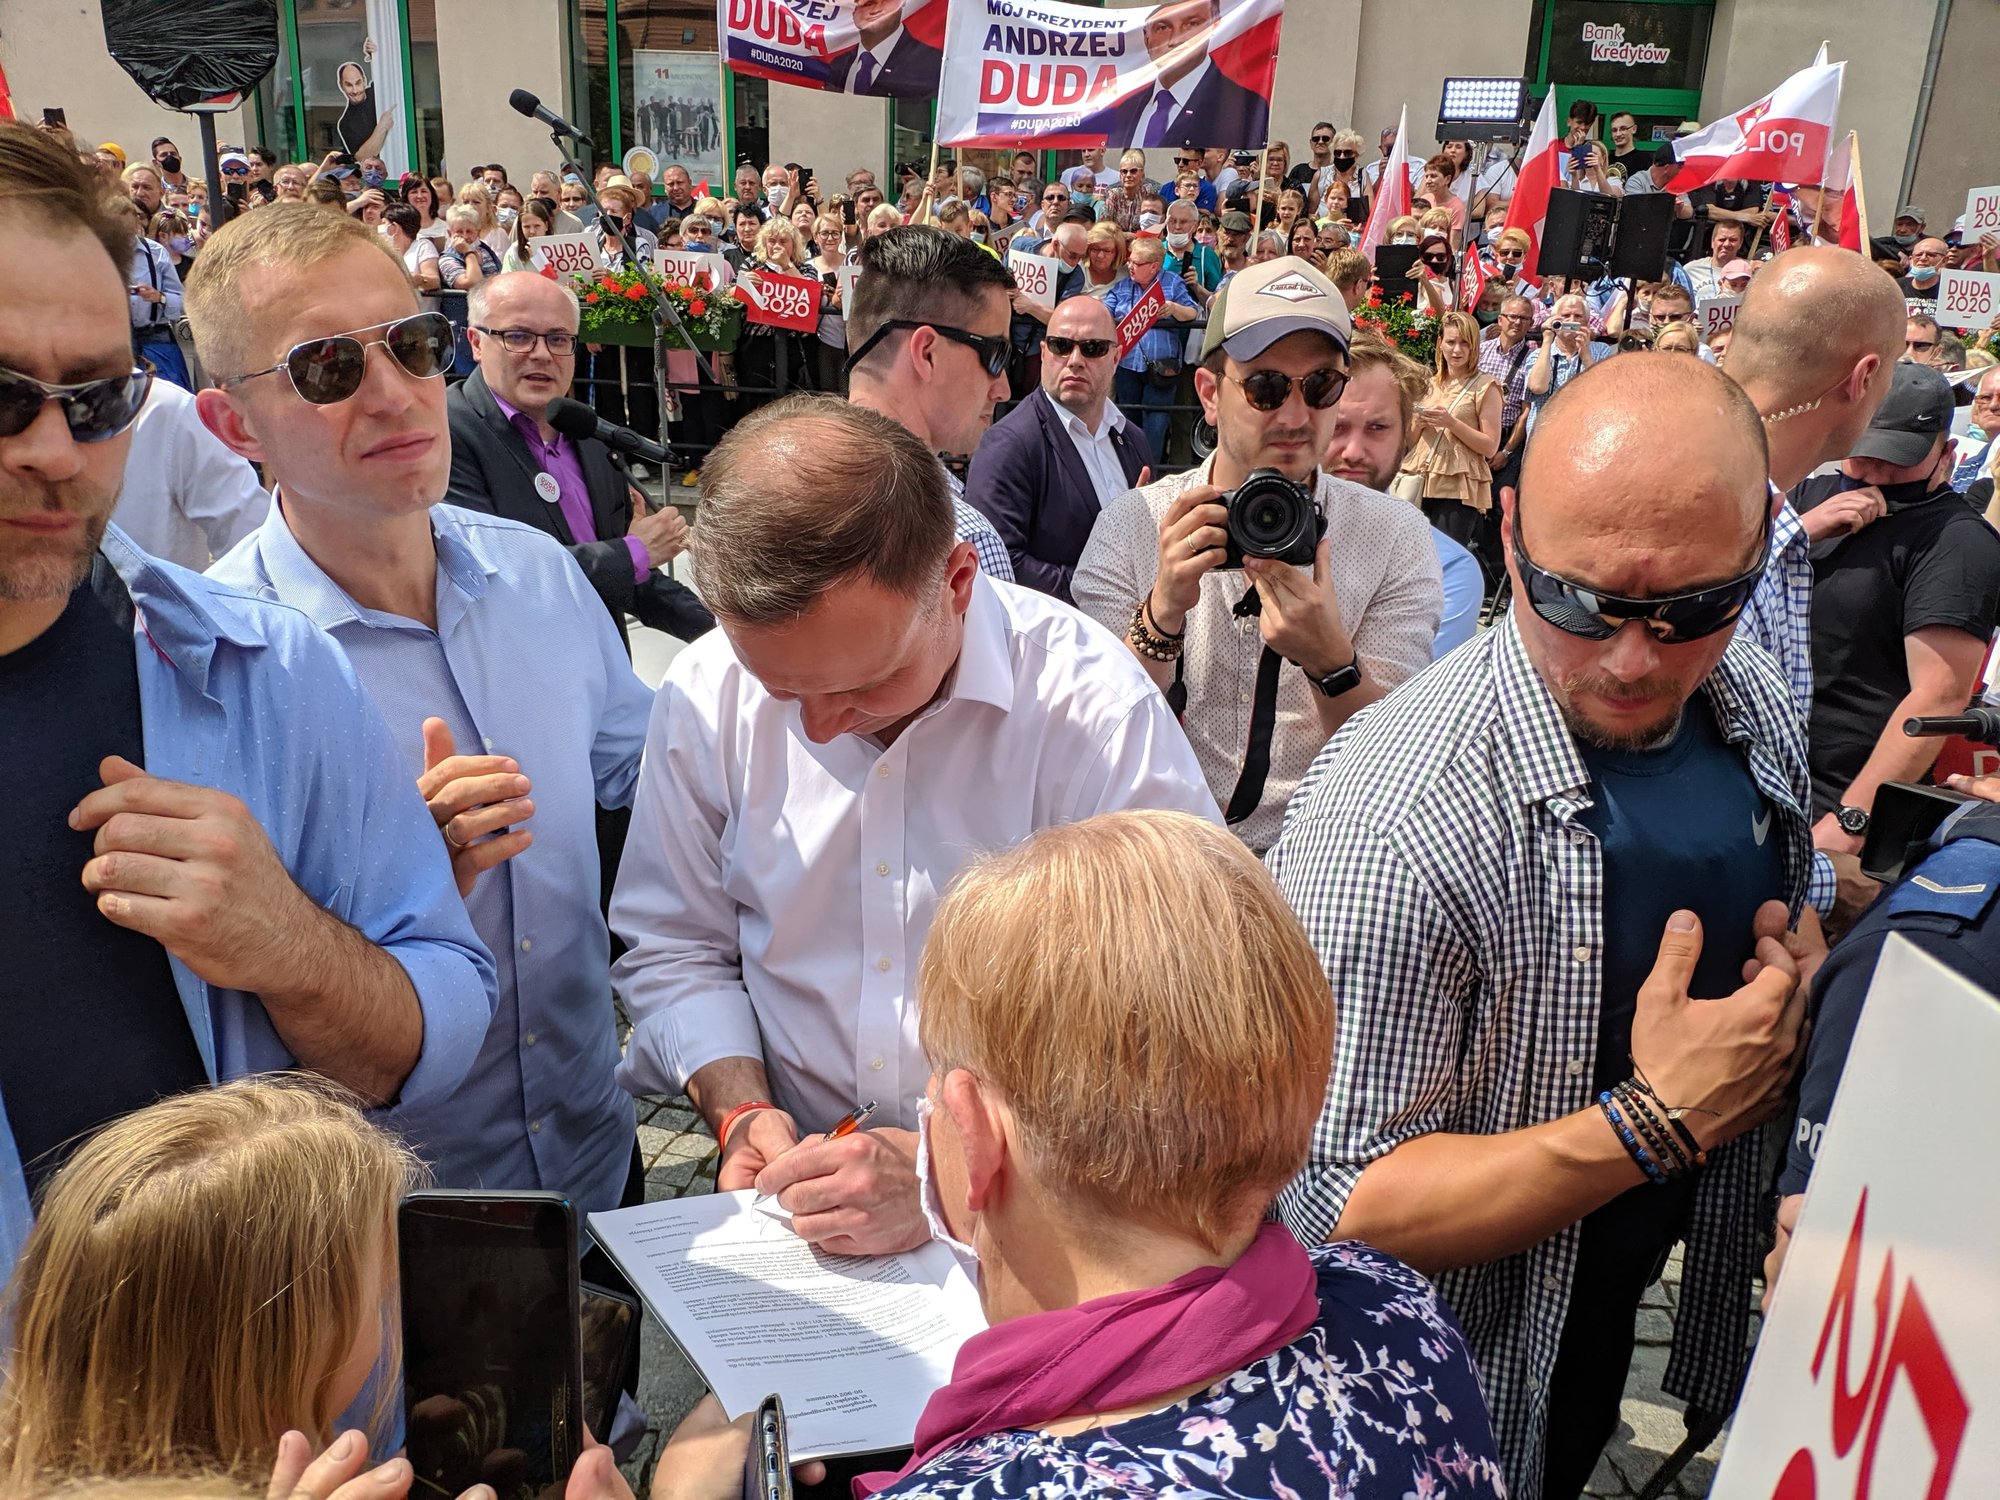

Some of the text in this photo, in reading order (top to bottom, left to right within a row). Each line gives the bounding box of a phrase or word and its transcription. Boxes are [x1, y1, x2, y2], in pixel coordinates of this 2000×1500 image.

[728, 0, 829, 55] DUDA
[1026, 10, 1128, 29] PREZYDENT
[982, 24, 1126, 57] ANDRZEJ
[1584, 24, 1622, 40] Bank
[750, 48, 803, 72] #DUDA2020
[1593, 43, 1668, 64] Kredytów
[979, 59, 1117, 107] DUDA
[1010, 116, 1081, 130] #DUDA2020
[1975, 195, 2000, 213] DU
[541, 242, 591, 258] DUDA
[761, 281, 811, 304] DUDA
[1947, 279, 1991, 298] DUDA
[761, 296, 810, 318] 2020
[1946, 295, 1991, 314] 2020
[1122, 296, 1158, 340] DUDA
[1126, 302, 1160, 346] 2020
